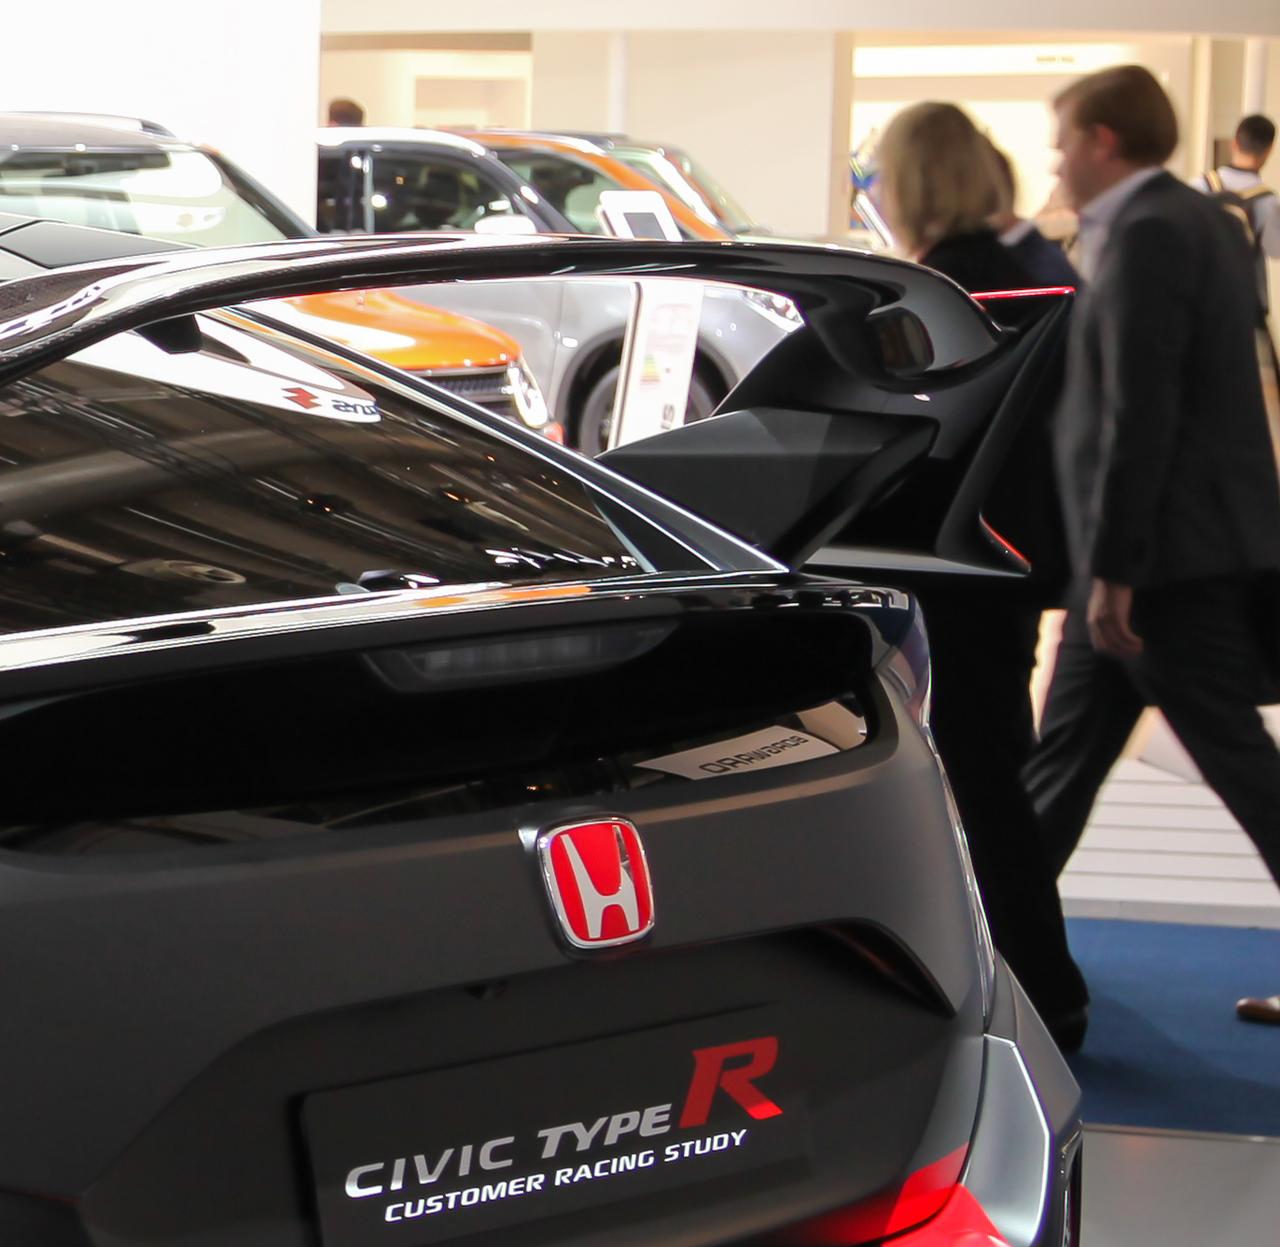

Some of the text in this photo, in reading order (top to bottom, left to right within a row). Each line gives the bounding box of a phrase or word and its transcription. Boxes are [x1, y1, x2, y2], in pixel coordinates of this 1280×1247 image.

[344, 1035, 784, 1199] CIVIC TYPE R
[384, 1128, 748, 1223] CUSTOMER RACING STUDY
